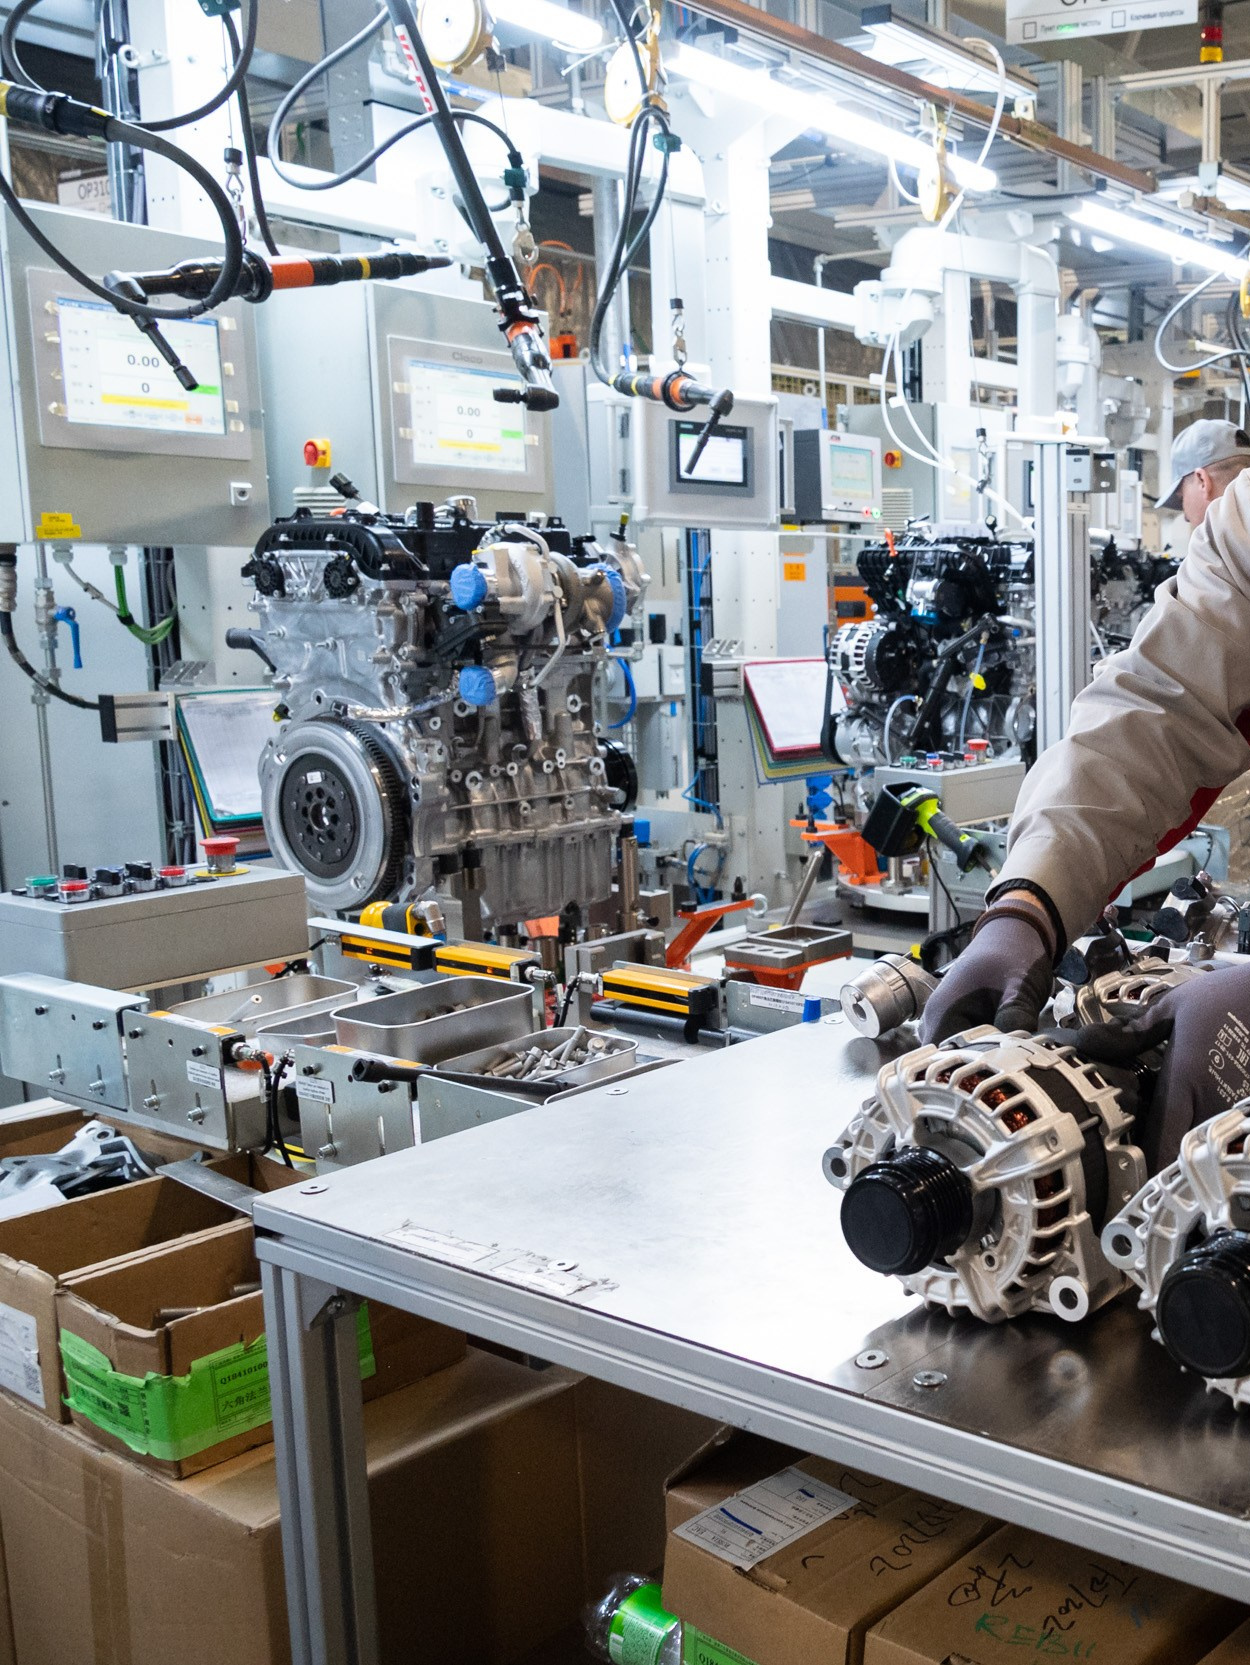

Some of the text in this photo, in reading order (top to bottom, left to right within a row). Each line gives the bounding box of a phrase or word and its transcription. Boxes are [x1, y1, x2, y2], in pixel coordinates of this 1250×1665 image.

[127, 354, 160, 369] 0.00
[141, 382, 150, 393] 0
[457, 405, 481, 417] 0.00
[466, 428, 474, 439] 0
